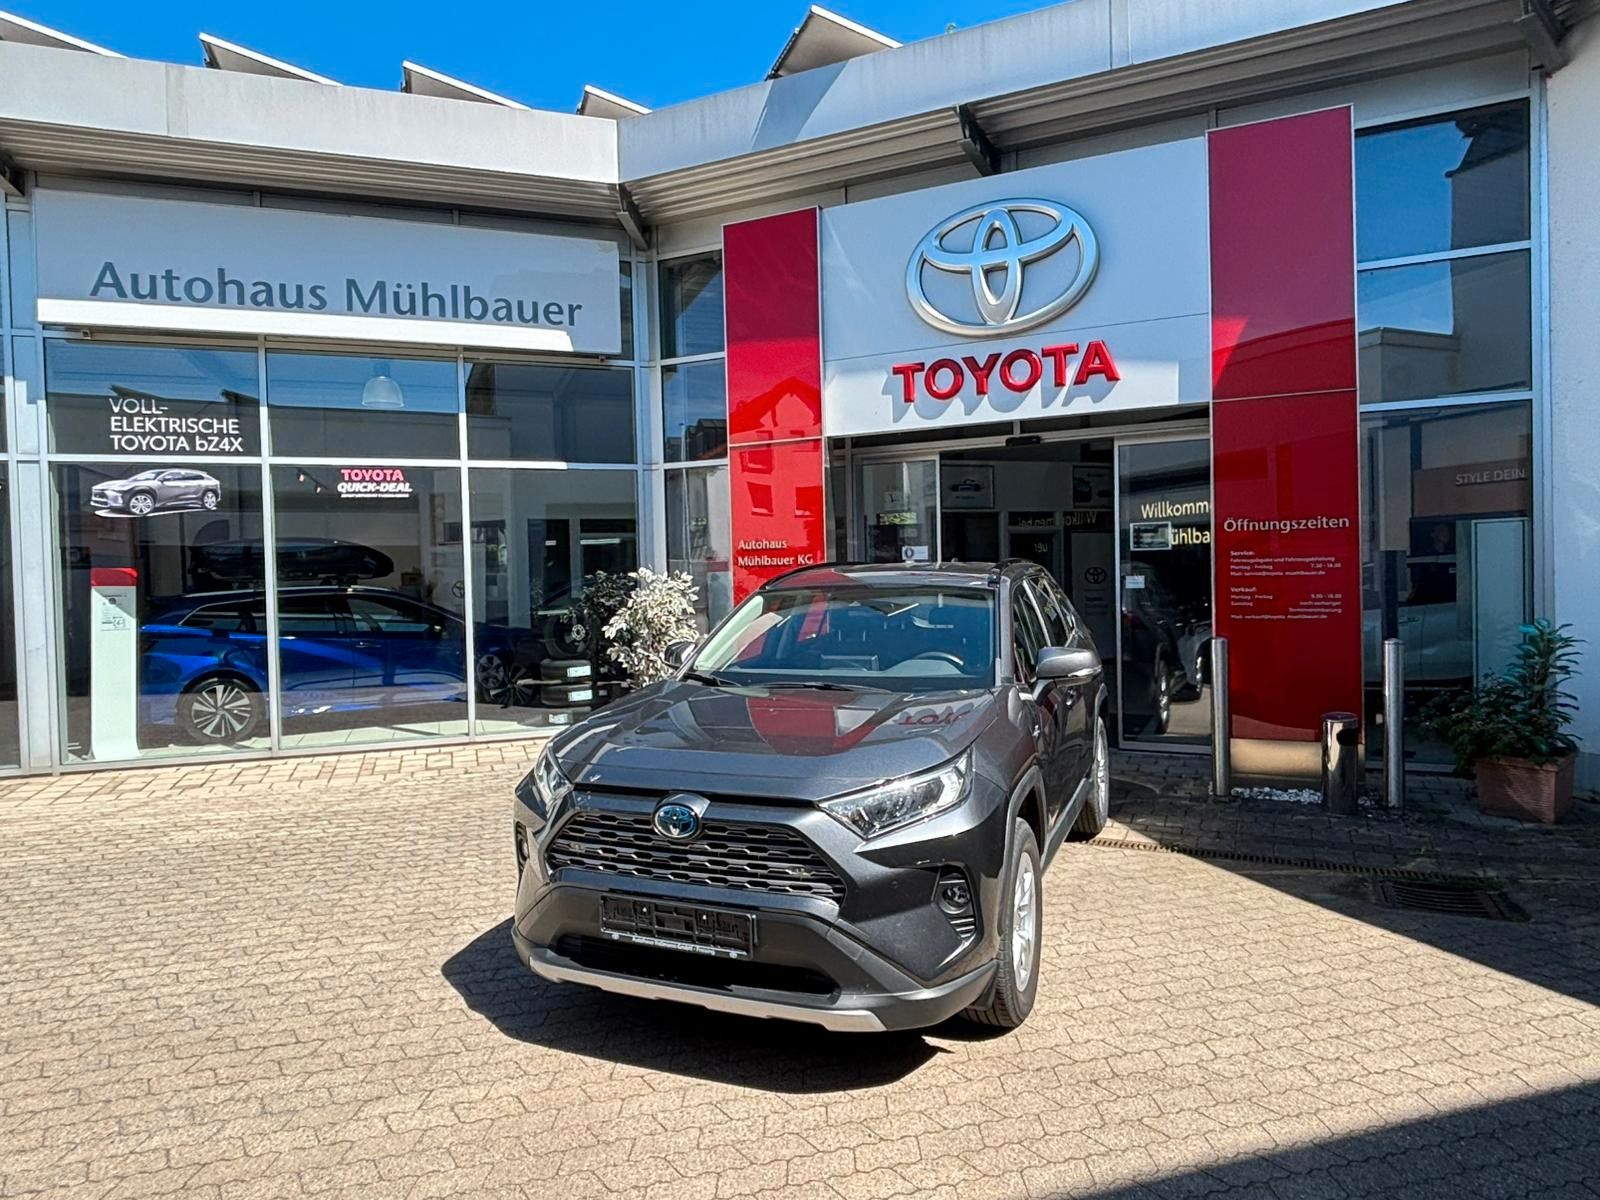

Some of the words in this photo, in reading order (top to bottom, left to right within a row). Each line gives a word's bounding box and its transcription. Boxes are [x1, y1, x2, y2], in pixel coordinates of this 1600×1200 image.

[89, 260, 328, 311] Autohaus
[344, 276, 583, 328] Mühlbauer
[892, 340, 1121, 403] TOYOTA
[109, 398, 168, 414] VOLL-
[110, 416, 240, 435] ELEKTRISCHE
[110, 435, 190, 452] TOYOTA
[196, 436, 244, 452] bZ4X
[341, 469, 404, 481] TOYOTA
[1456, 471, 1490, 486] STYLE
[337, 482, 413, 493] QUICK-DEAL
[1141, 501, 1211, 519] Willkomm
[1224, 516, 1350, 533] Öffnungszeiten
[738, 539, 787, 549] Autohaus
[1171, 527, 1211, 545] ühlba
[738, 555, 794, 566] Mühlbauer
[797, 554, 813, 564] KG
